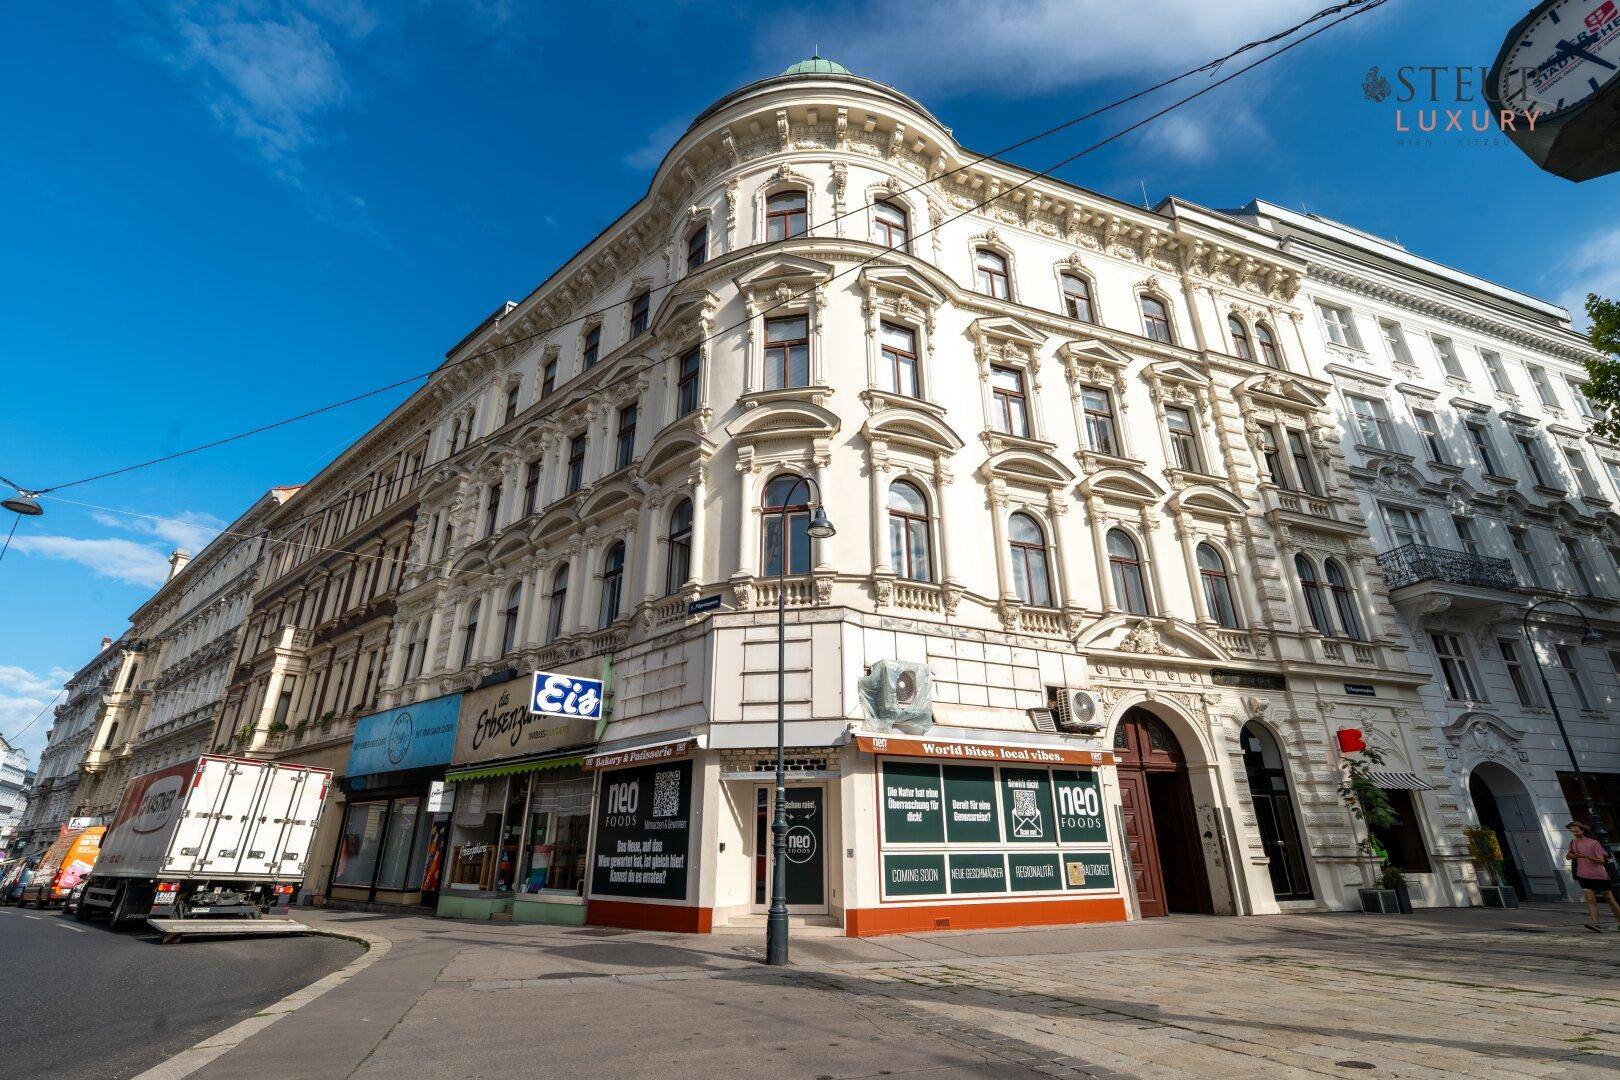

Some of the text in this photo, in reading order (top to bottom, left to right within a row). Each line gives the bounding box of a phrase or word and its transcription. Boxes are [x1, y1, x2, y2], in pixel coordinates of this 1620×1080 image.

[537, 674, 600, 716] Eis
[873, 738, 887, 748] neo
[595, 746, 672, 767] Bakery & Patisserie
[922, 743, 963, 755] World
[1000, 748, 1029, 760] local
[1031, 751, 1065, 762] vibes.
[1090, 752, 1102, 760] neo
[608, 782, 639, 814] neo
[887, 787, 939, 798] Die Natur hat eine
[784, 800, 801, 809] Schau
[888, 797, 939, 811] Überraschung für
[952, 800, 991, 810] Bereit für eine
[1058, 786, 1099, 817] neo
[605, 815, 637, 827] FOODS
[907, 812, 923, 822] dich!
[953, 812, 991, 822] Genussreise?
[1061, 817, 1101, 829] FOODS
[616, 840, 627, 852] Das
[642, 838, 652, 852] auf
[652, 838, 662, 852] das
[788, 835, 810, 848] neo
[610, 854, 633, 869] gewartet
[652, 853, 669, 870] gleich
[669, 853, 684, 868] hier!
[628, 870, 635, 883] du
[635, 872, 642, 883] es
[642, 870, 666, 884] erraten?
[891, 868, 939, 883] COMING SOON
[951, 866, 1004, 879] NEUE GESCHMÄCKER
[1015, 863, 1054, 878] REGIONALITÄT
